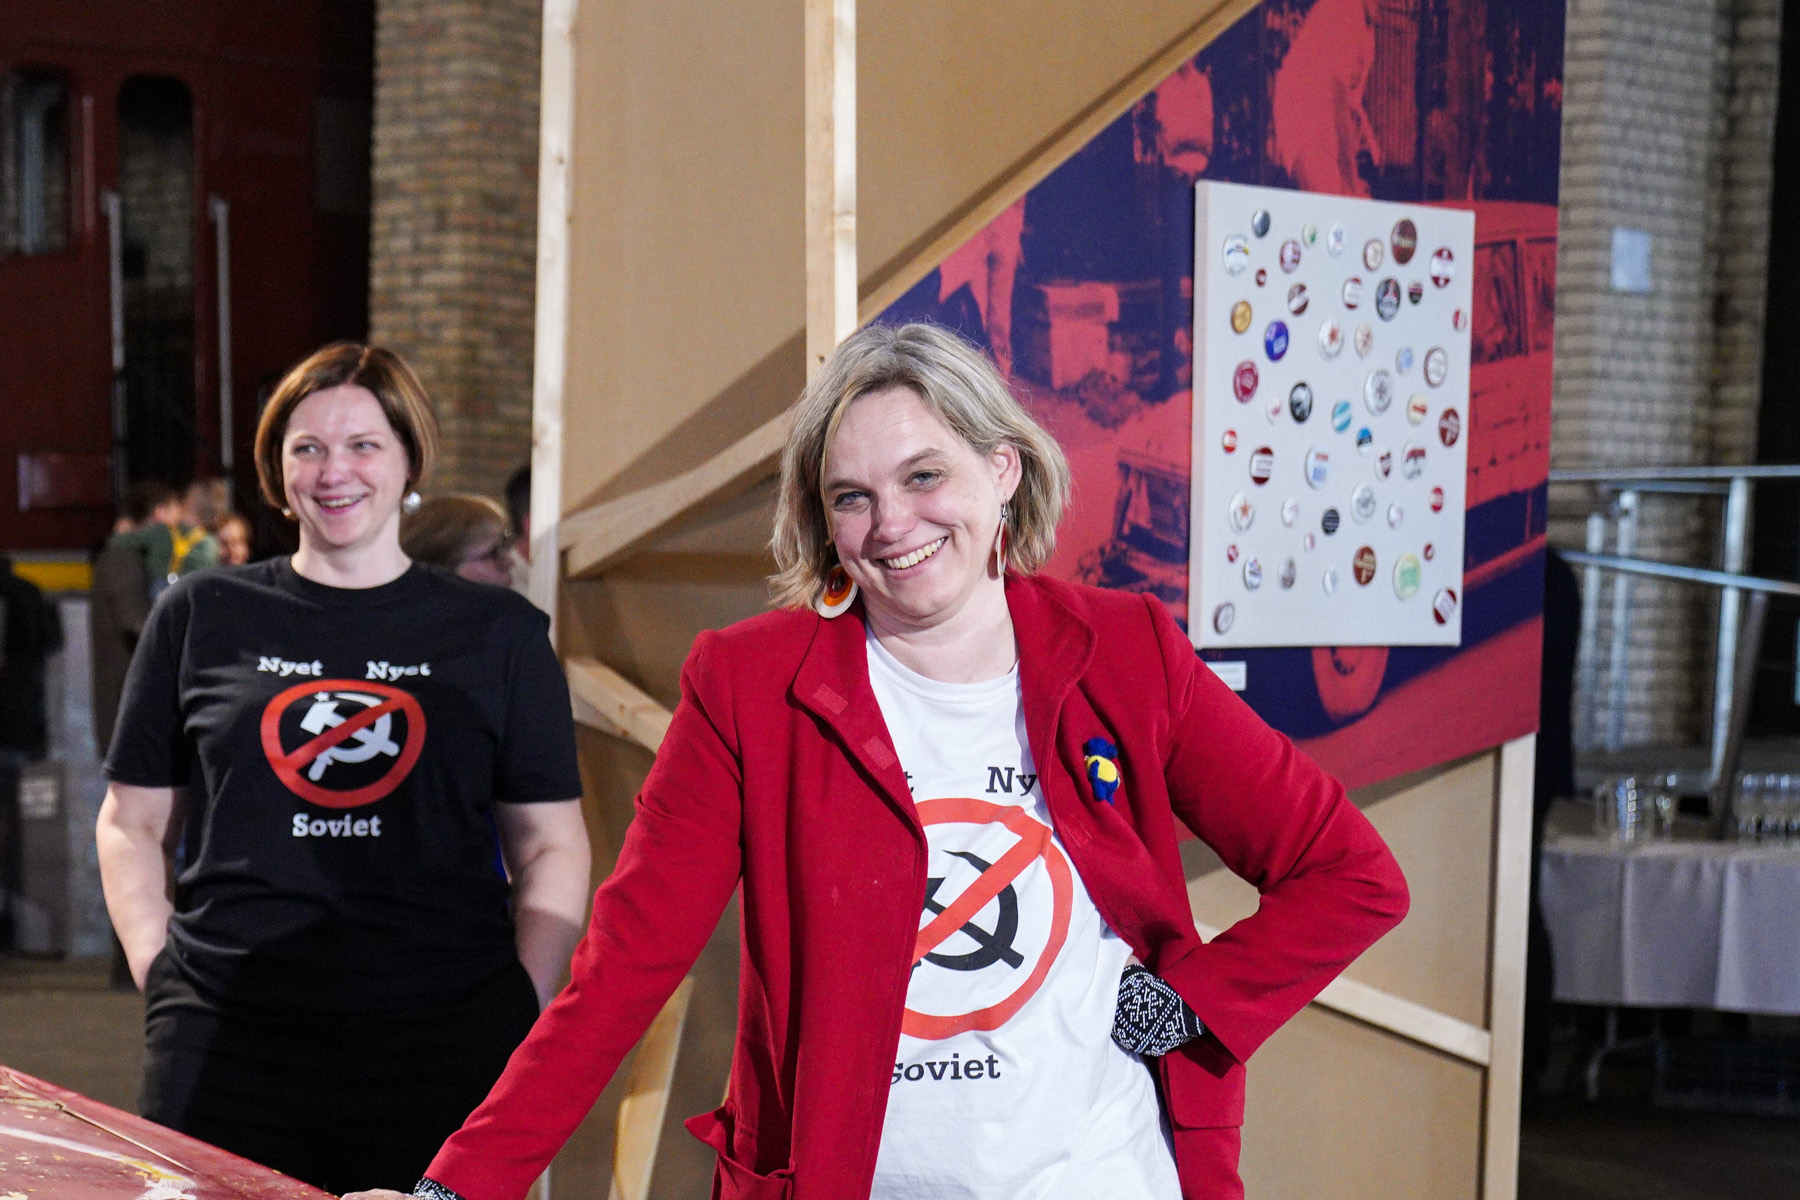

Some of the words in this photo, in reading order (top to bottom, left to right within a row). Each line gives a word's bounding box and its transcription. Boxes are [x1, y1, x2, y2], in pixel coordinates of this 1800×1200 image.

[257, 656, 324, 677] Nyet
[365, 661, 431, 681] Nyet
[986, 766, 1038, 796] Ny
[292, 813, 381, 837] Soviet
